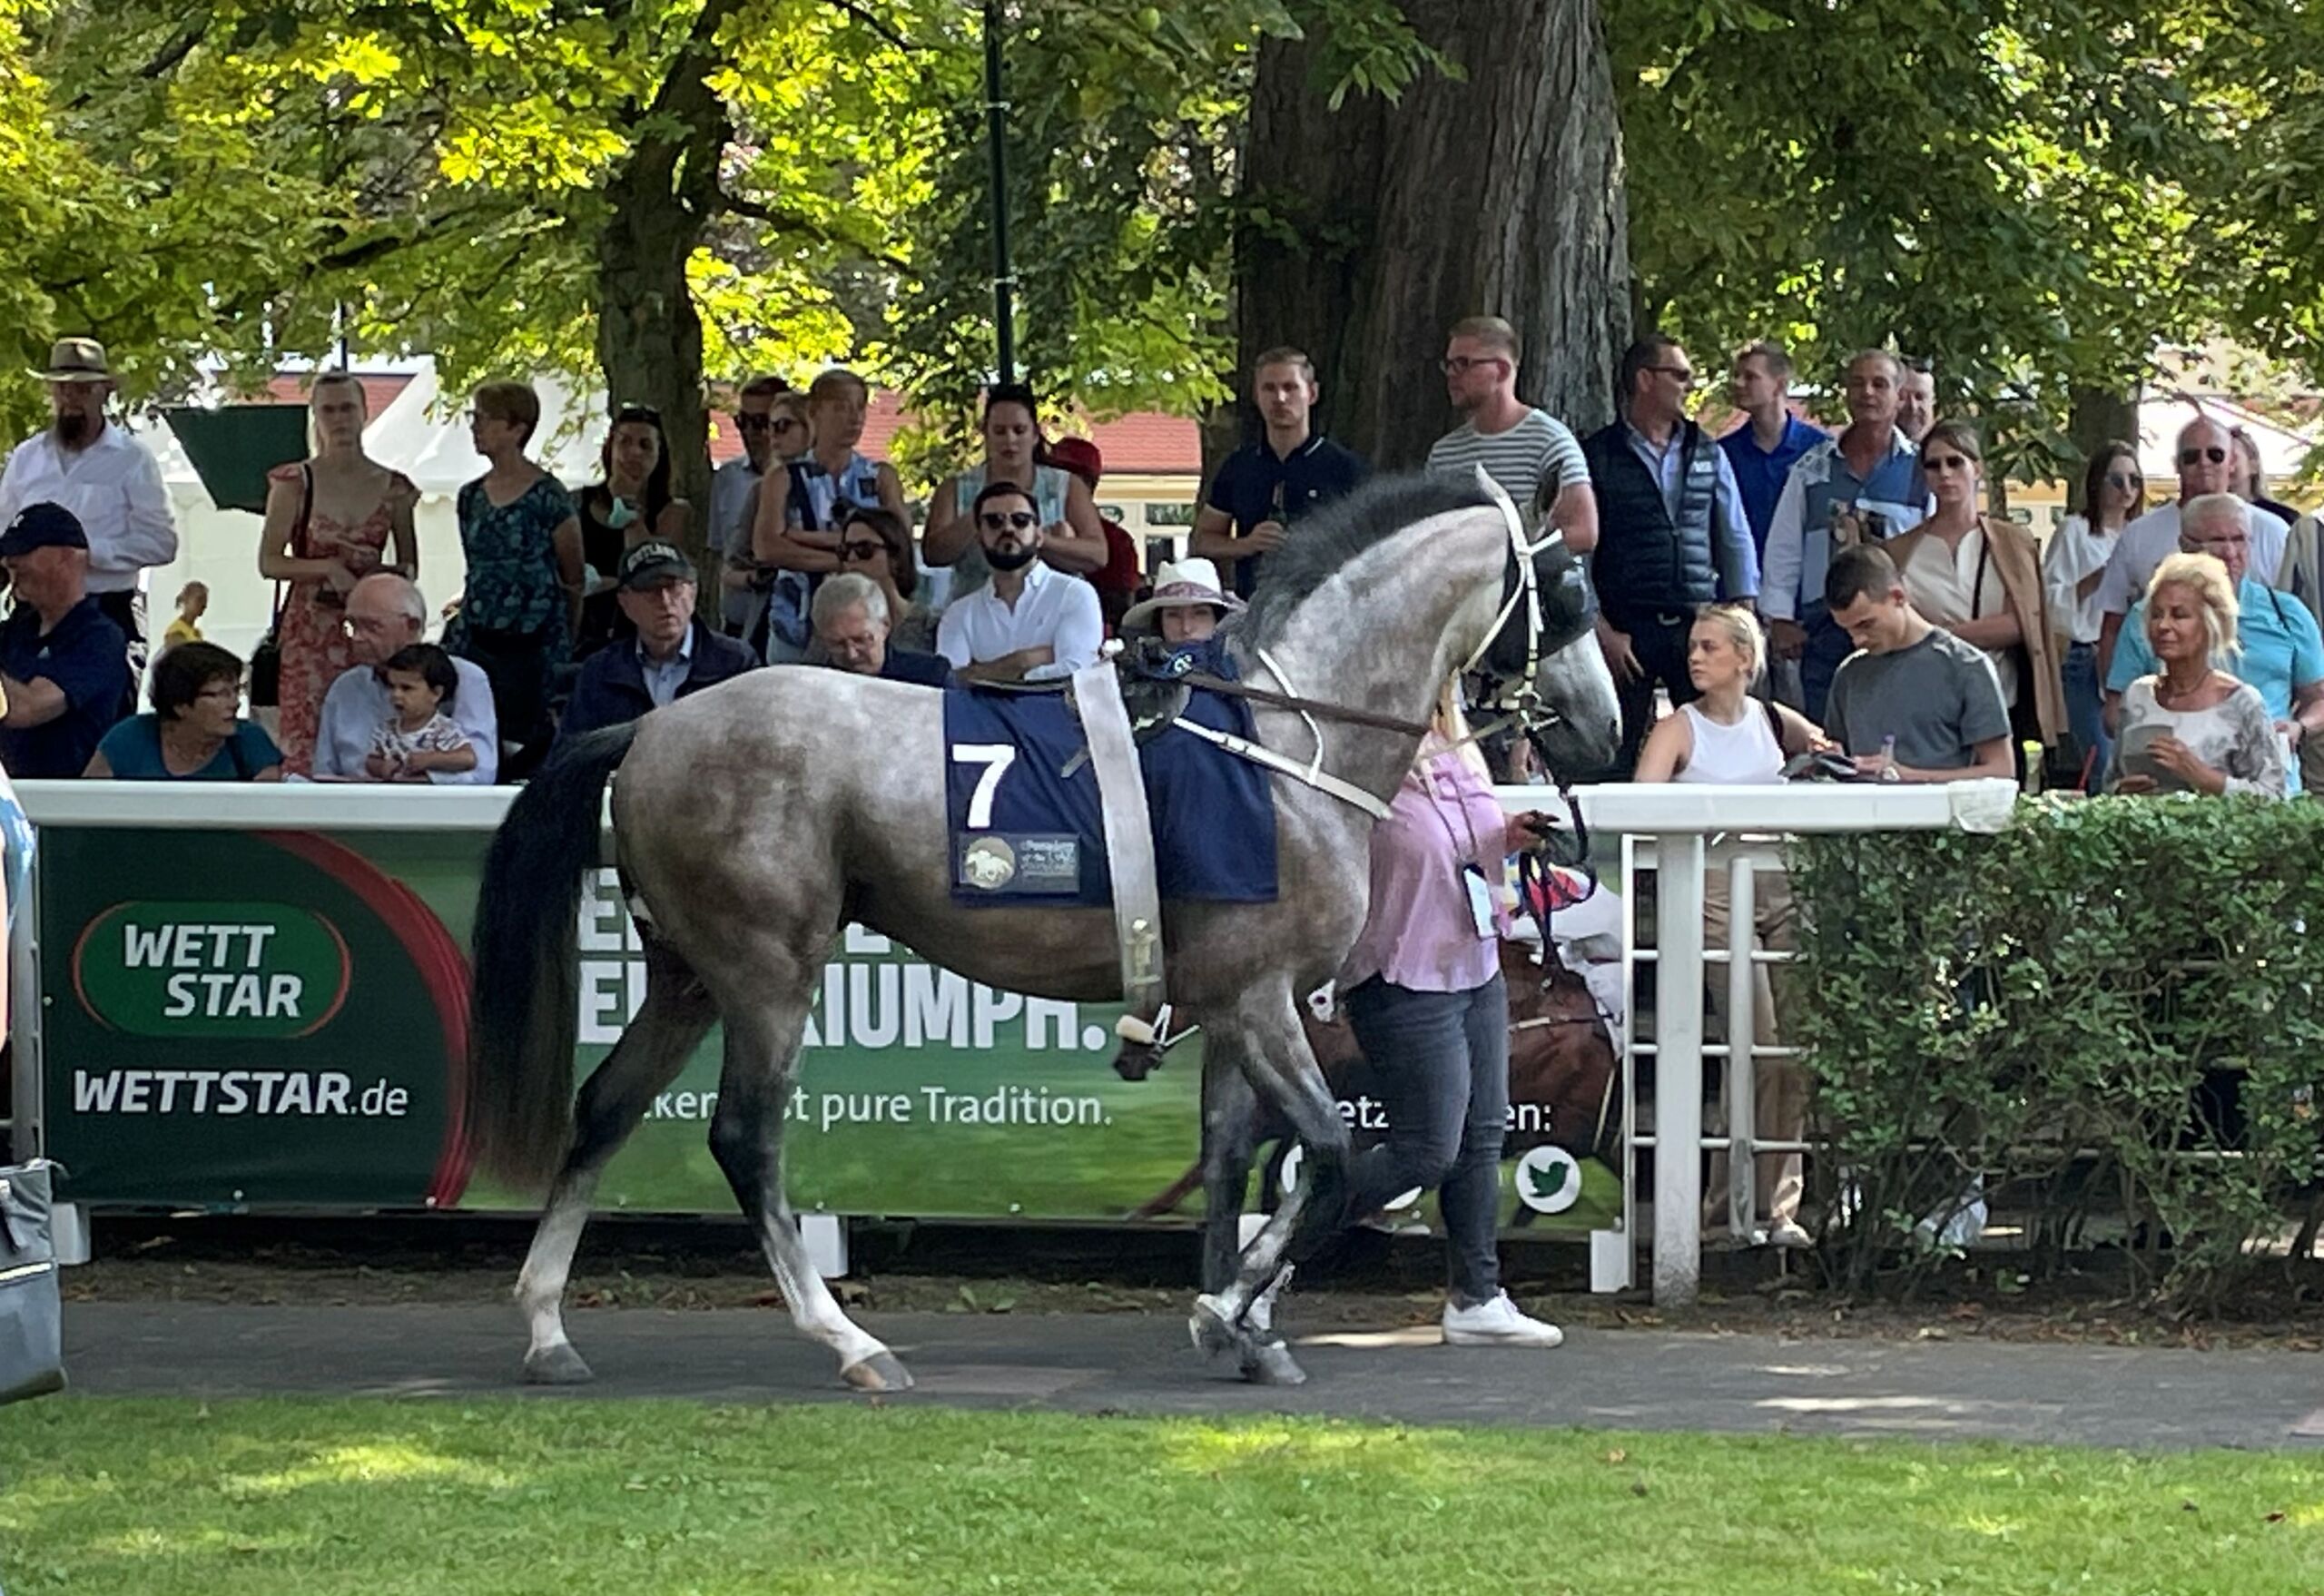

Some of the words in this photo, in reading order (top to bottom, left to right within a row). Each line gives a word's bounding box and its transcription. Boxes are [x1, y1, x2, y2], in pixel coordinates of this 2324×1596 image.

[952, 744, 1015, 828] 7
[123, 924, 276, 968] WETT
[163, 973, 303, 1018] STAR
[74, 1069, 409, 1116] WETTSTAR.de
[822, 1093, 912, 1133] pure
[920, 1086, 1113, 1126] Tradition.
